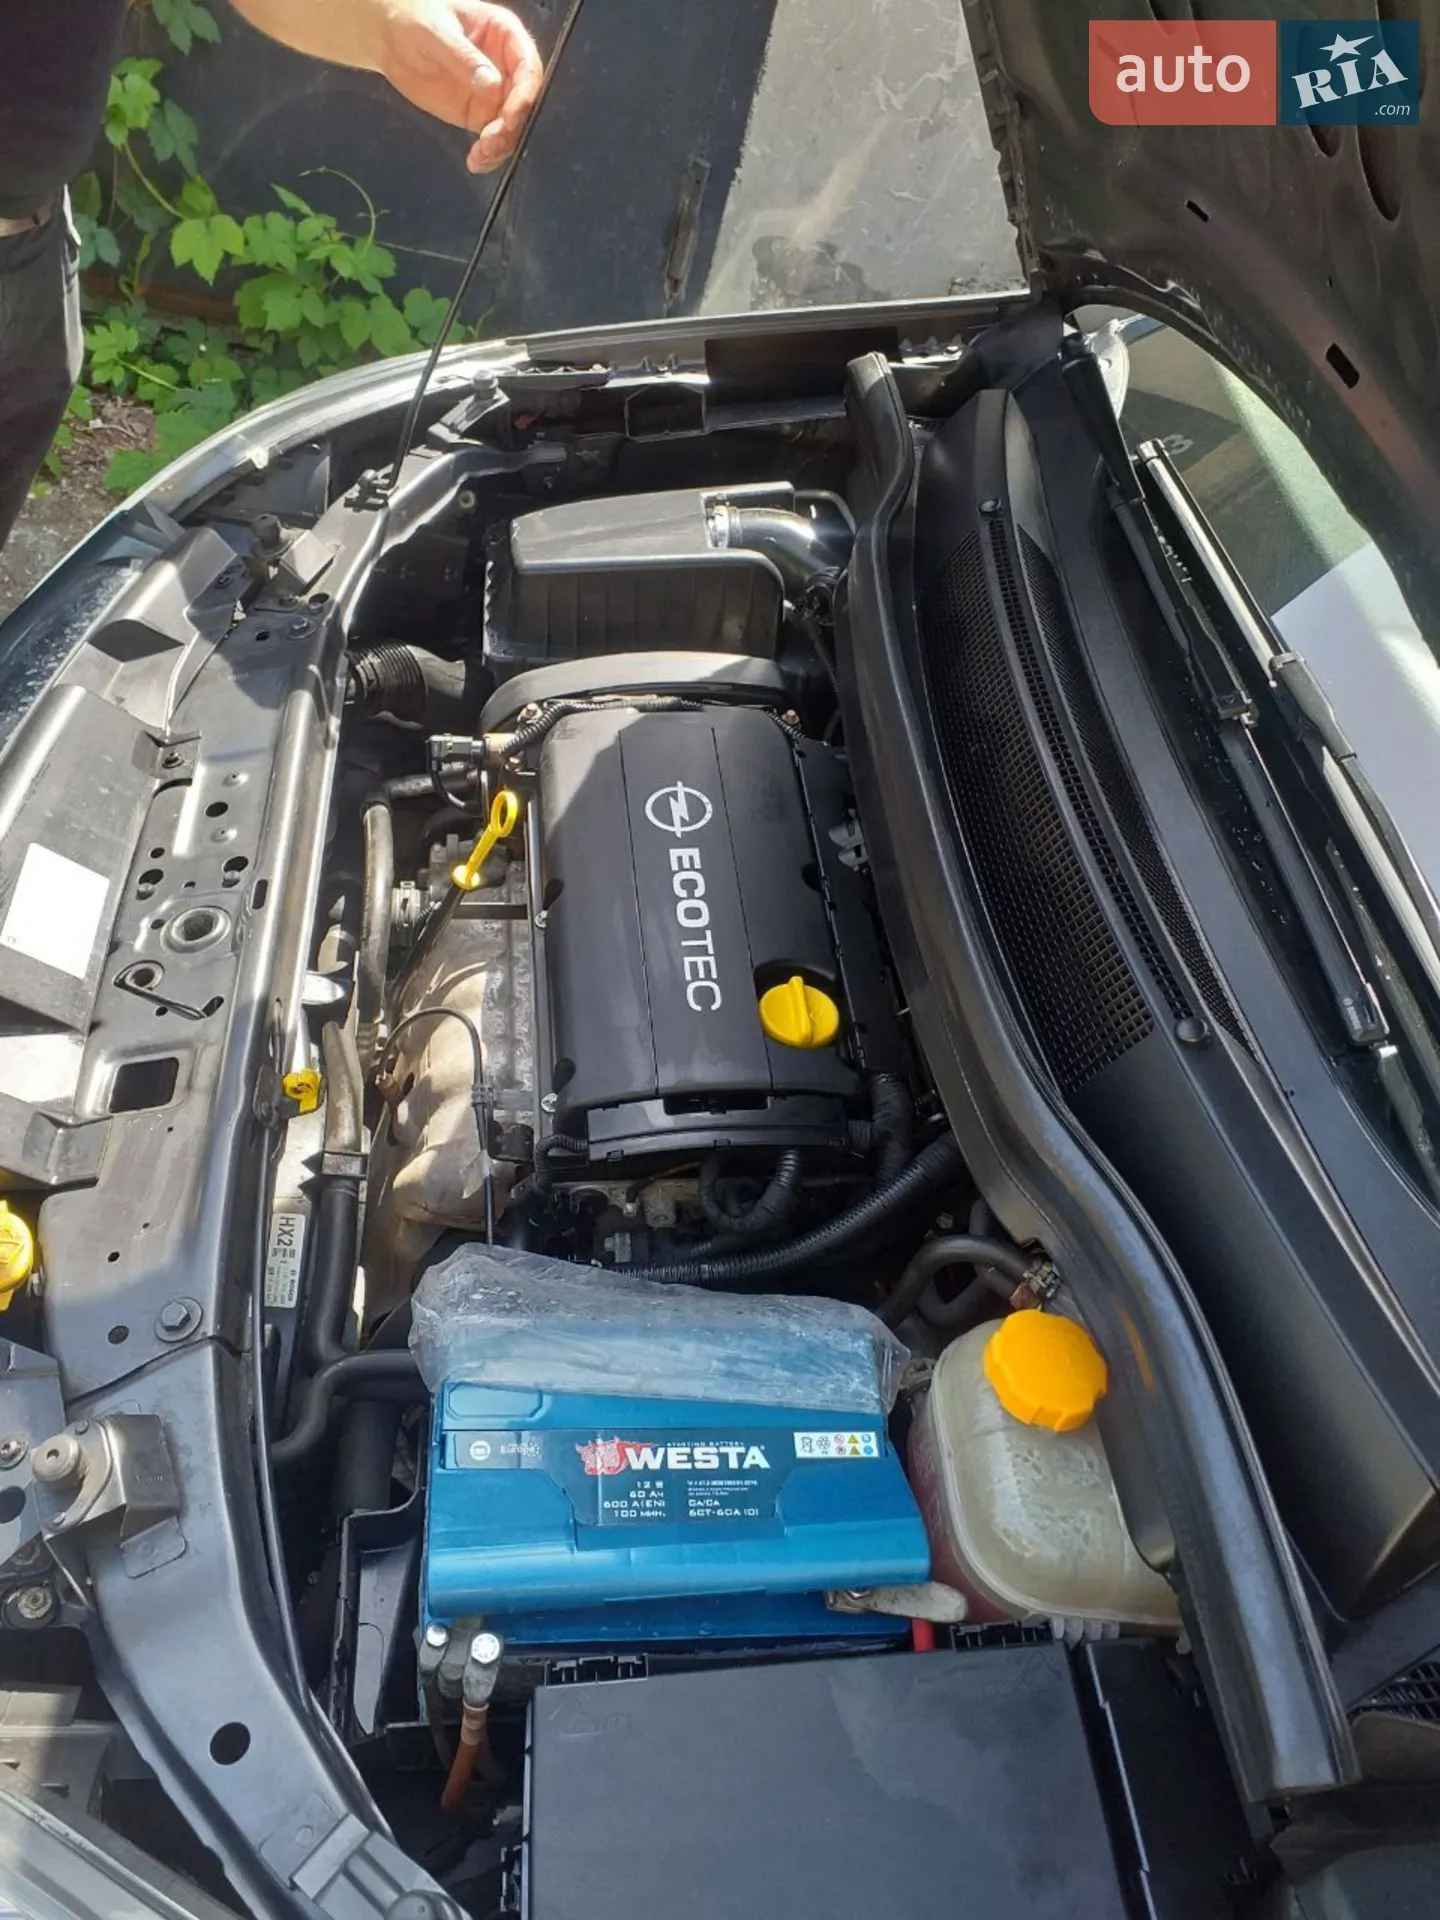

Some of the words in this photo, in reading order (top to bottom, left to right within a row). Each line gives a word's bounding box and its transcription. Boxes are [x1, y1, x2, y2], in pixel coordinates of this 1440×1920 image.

[668, 847, 722, 1012] ECOTEC
[276, 1216, 296, 1247] HX2
[625, 1446, 771, 1470] WESTA
[637, 1481, 650, 1489] 12
[629, 1490, 646, 1498] 60
[603, 1500, 628, 1508] 600
[614, 1510, 637, 1518] 100
